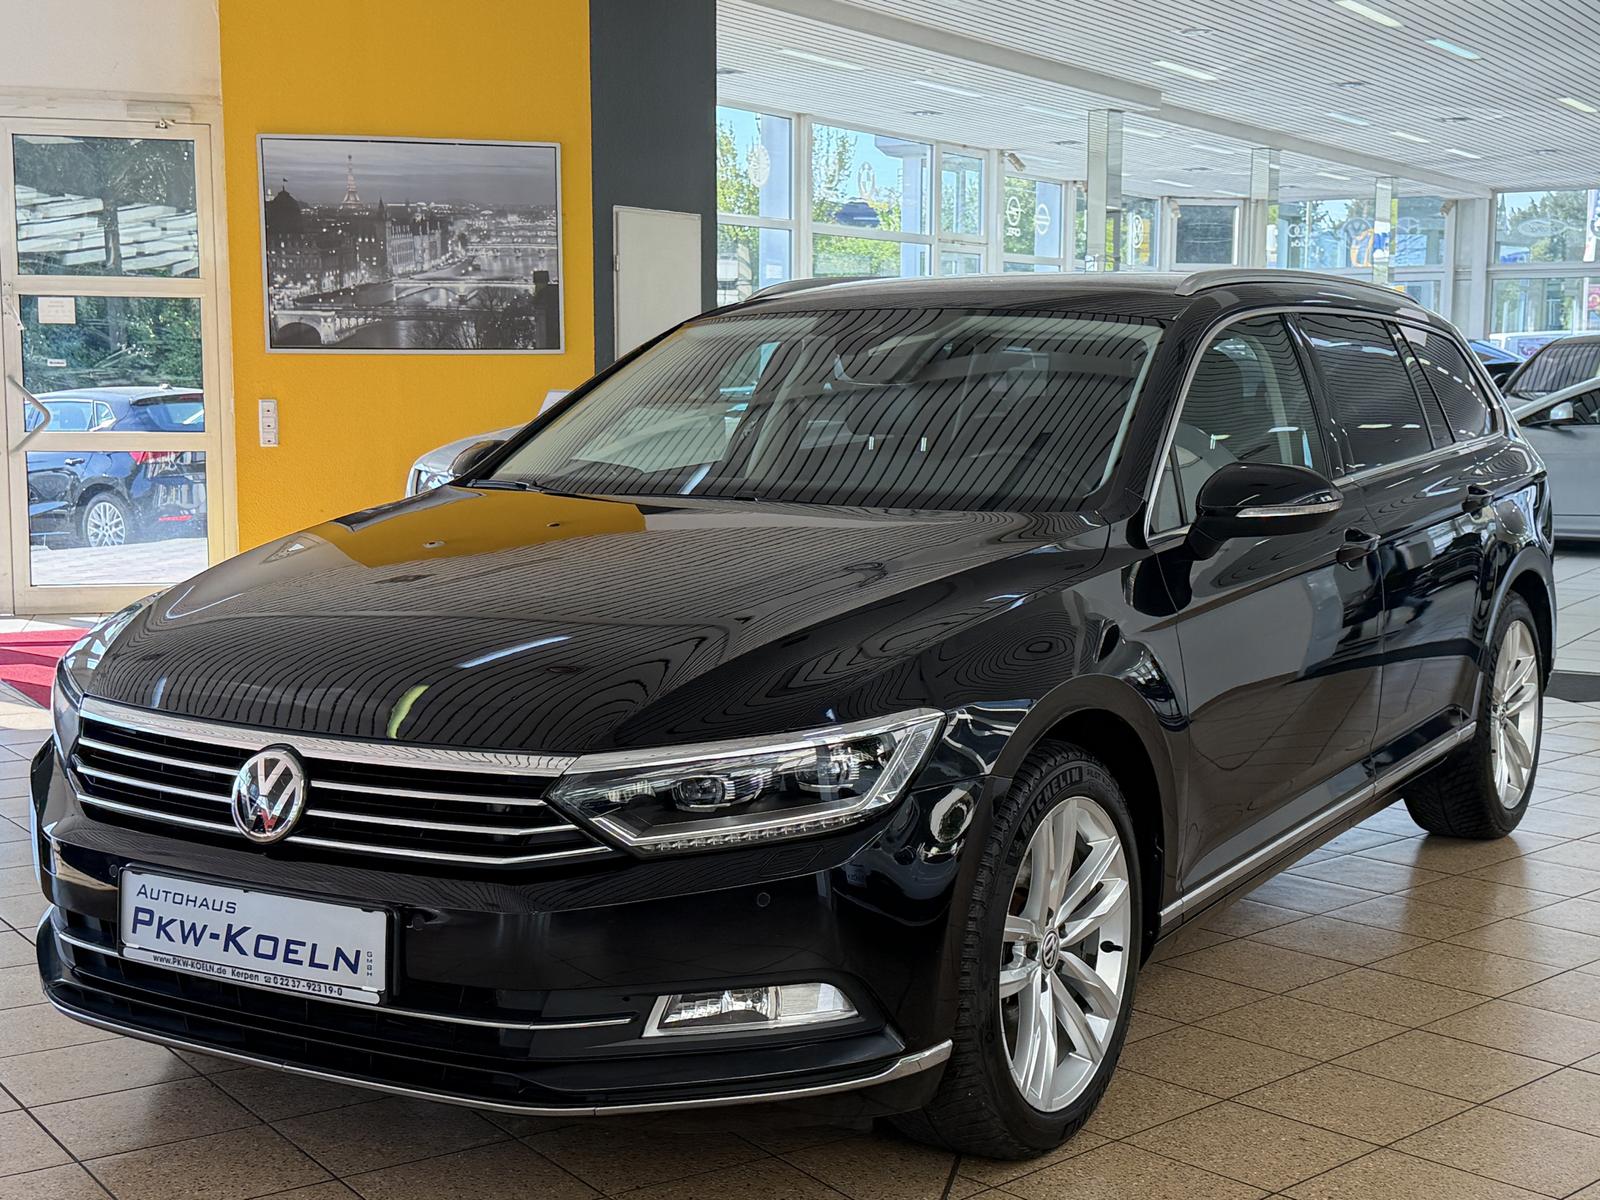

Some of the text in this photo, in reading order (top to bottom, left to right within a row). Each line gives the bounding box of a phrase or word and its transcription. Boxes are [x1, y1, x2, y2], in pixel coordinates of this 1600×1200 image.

[233, 752, 304, 840] VW
[1021, 767, 1082, 838] MICHELIN
[136, 884, 238, 914] AUTOHAUS
[131, 906, 361, 975] PKW-KOELN
[153, 953, 227, 976] www.PKW-KOELN.de
[231, 968, 260, 983] Kerpen
